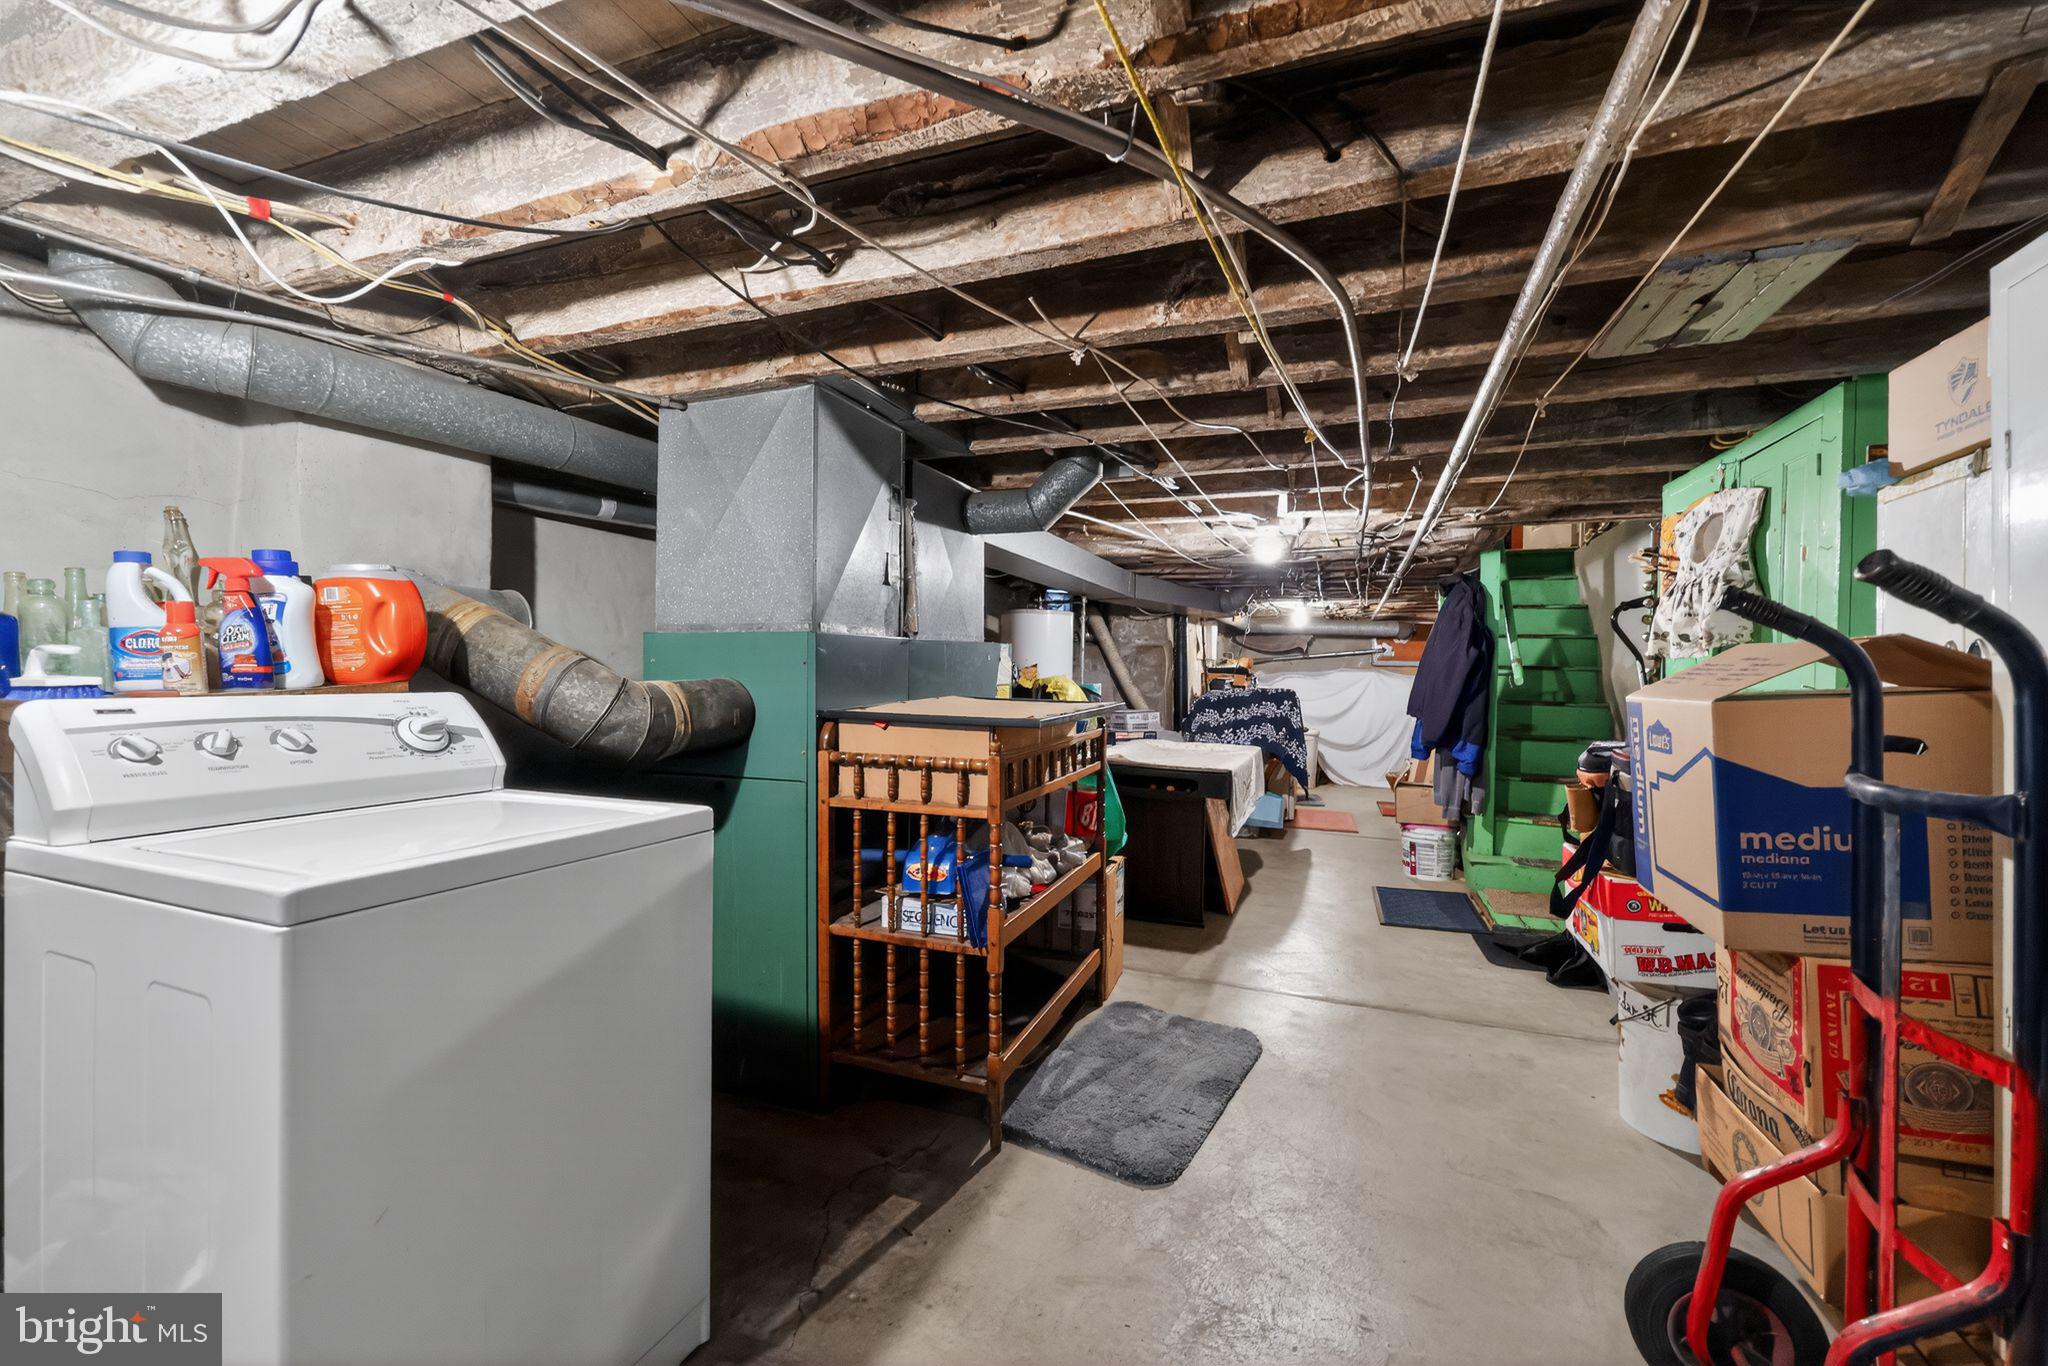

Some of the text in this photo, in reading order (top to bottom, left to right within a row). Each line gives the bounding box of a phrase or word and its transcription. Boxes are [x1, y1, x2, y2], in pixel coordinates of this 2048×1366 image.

[1935, 400, 1992, 434] TYNDALE
[1741, 853, 1810, 865] mediana
[1726, 1067, 1782, 1143] Corona
